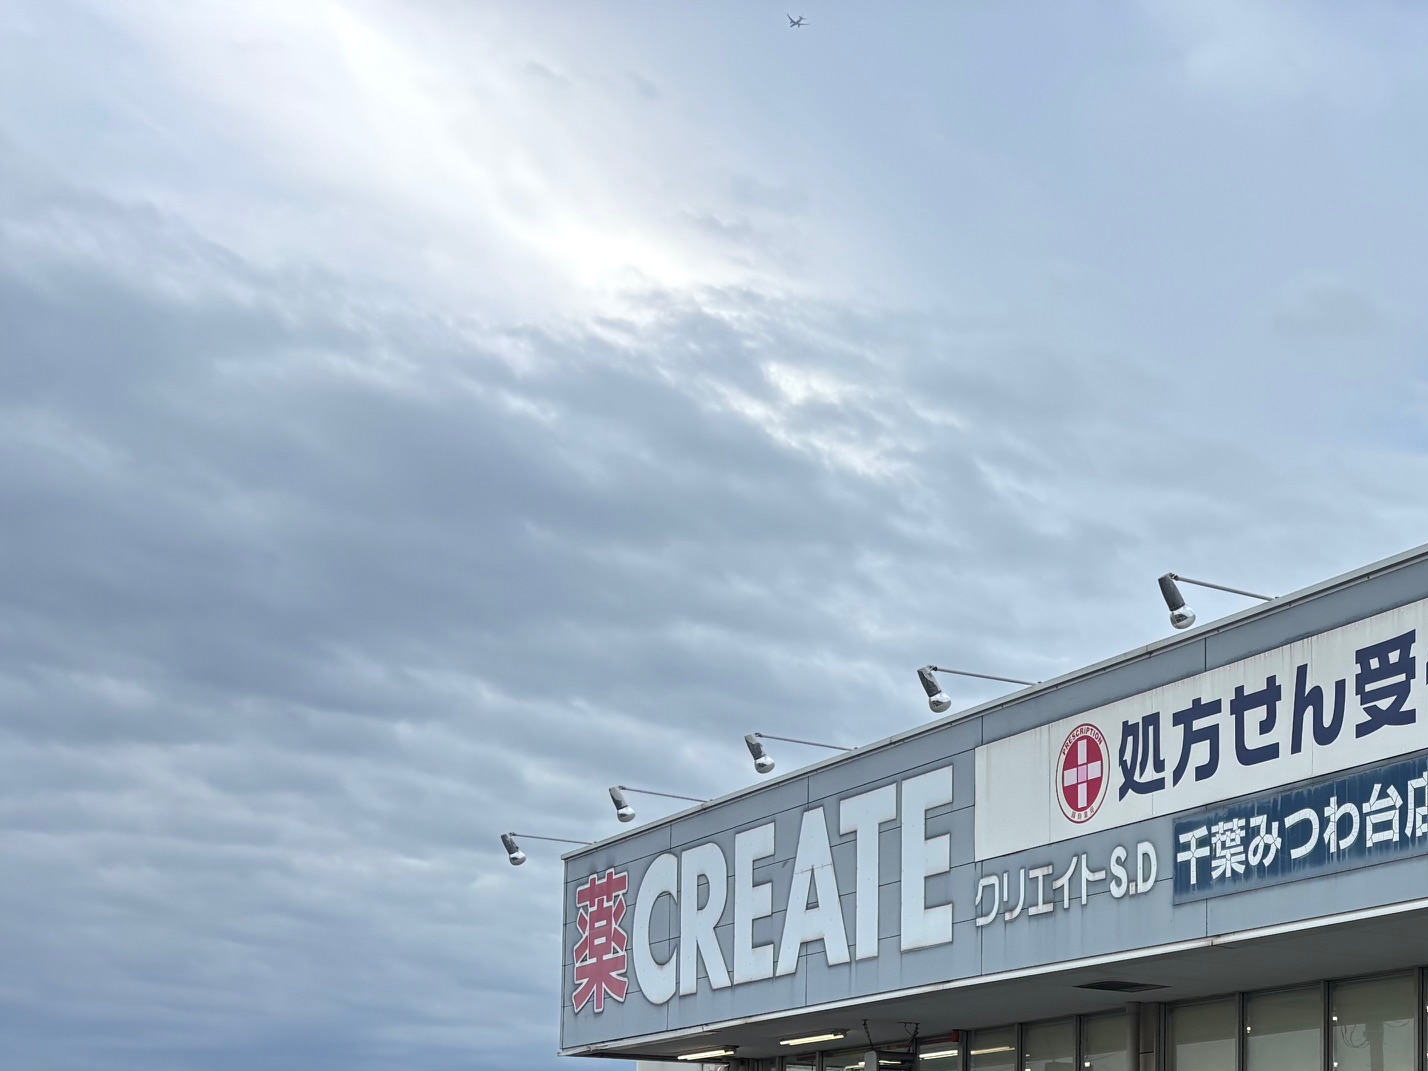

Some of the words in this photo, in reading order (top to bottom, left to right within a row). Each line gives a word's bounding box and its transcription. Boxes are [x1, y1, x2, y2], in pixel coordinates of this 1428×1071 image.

[1061, 726, 1103, 756] PRESCRIPTION
[572, 867, 629, 1014] 薬
[632, 763, 954, 1005] CREATE
